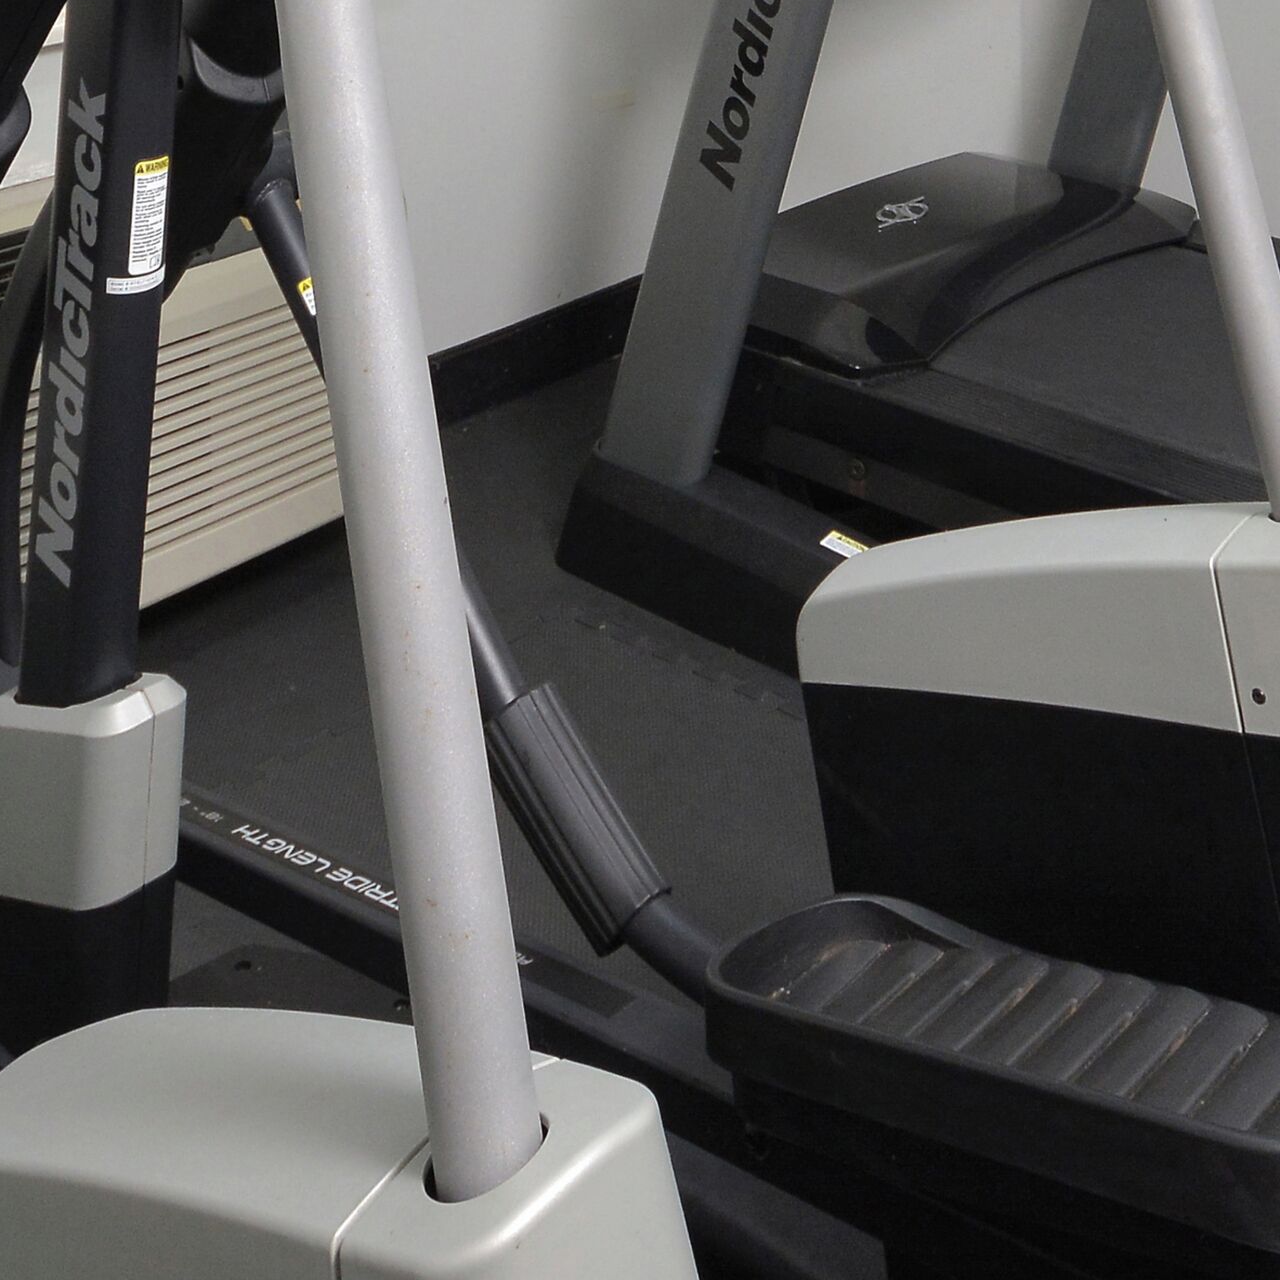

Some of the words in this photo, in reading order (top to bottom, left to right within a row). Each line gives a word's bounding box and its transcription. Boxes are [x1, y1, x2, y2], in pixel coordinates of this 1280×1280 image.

[34, 77, 107, 589] NordicTrack
[231, 824, 332, 874] LENGTH
[324, 867, 400, 911] TRIDE
